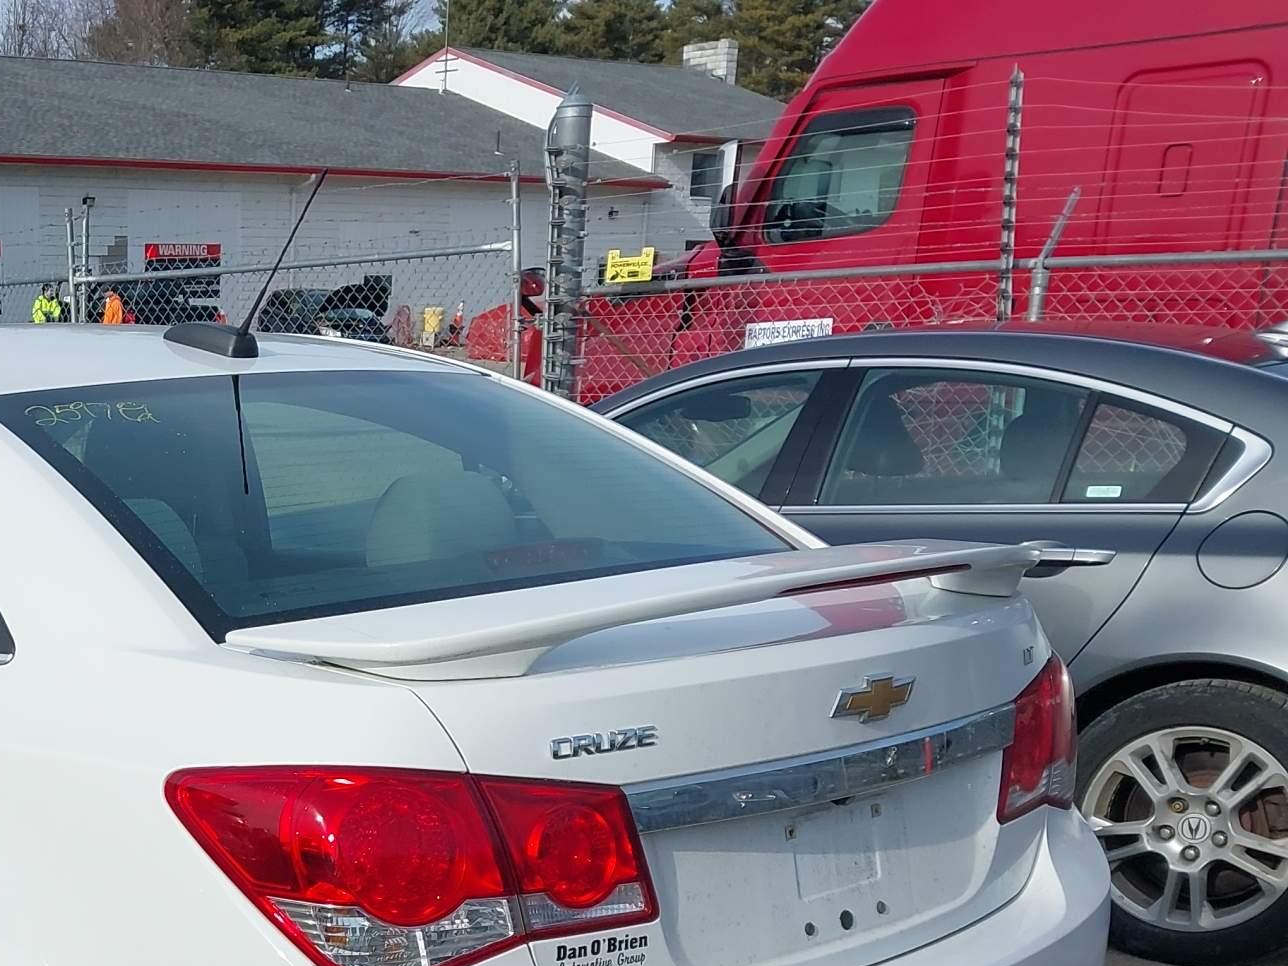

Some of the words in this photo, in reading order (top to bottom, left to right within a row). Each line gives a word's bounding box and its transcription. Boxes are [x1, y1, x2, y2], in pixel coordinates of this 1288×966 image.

[159, 244, 208, 256] WARNING
[748, 326, 780, 341] RAPTORS
[551, 725, 658, 760] CRUZE
[556, 945, 587, 961] Dan
[591, 934, 648, 956] O'Brien
[617, 952, 646, 966] Group
